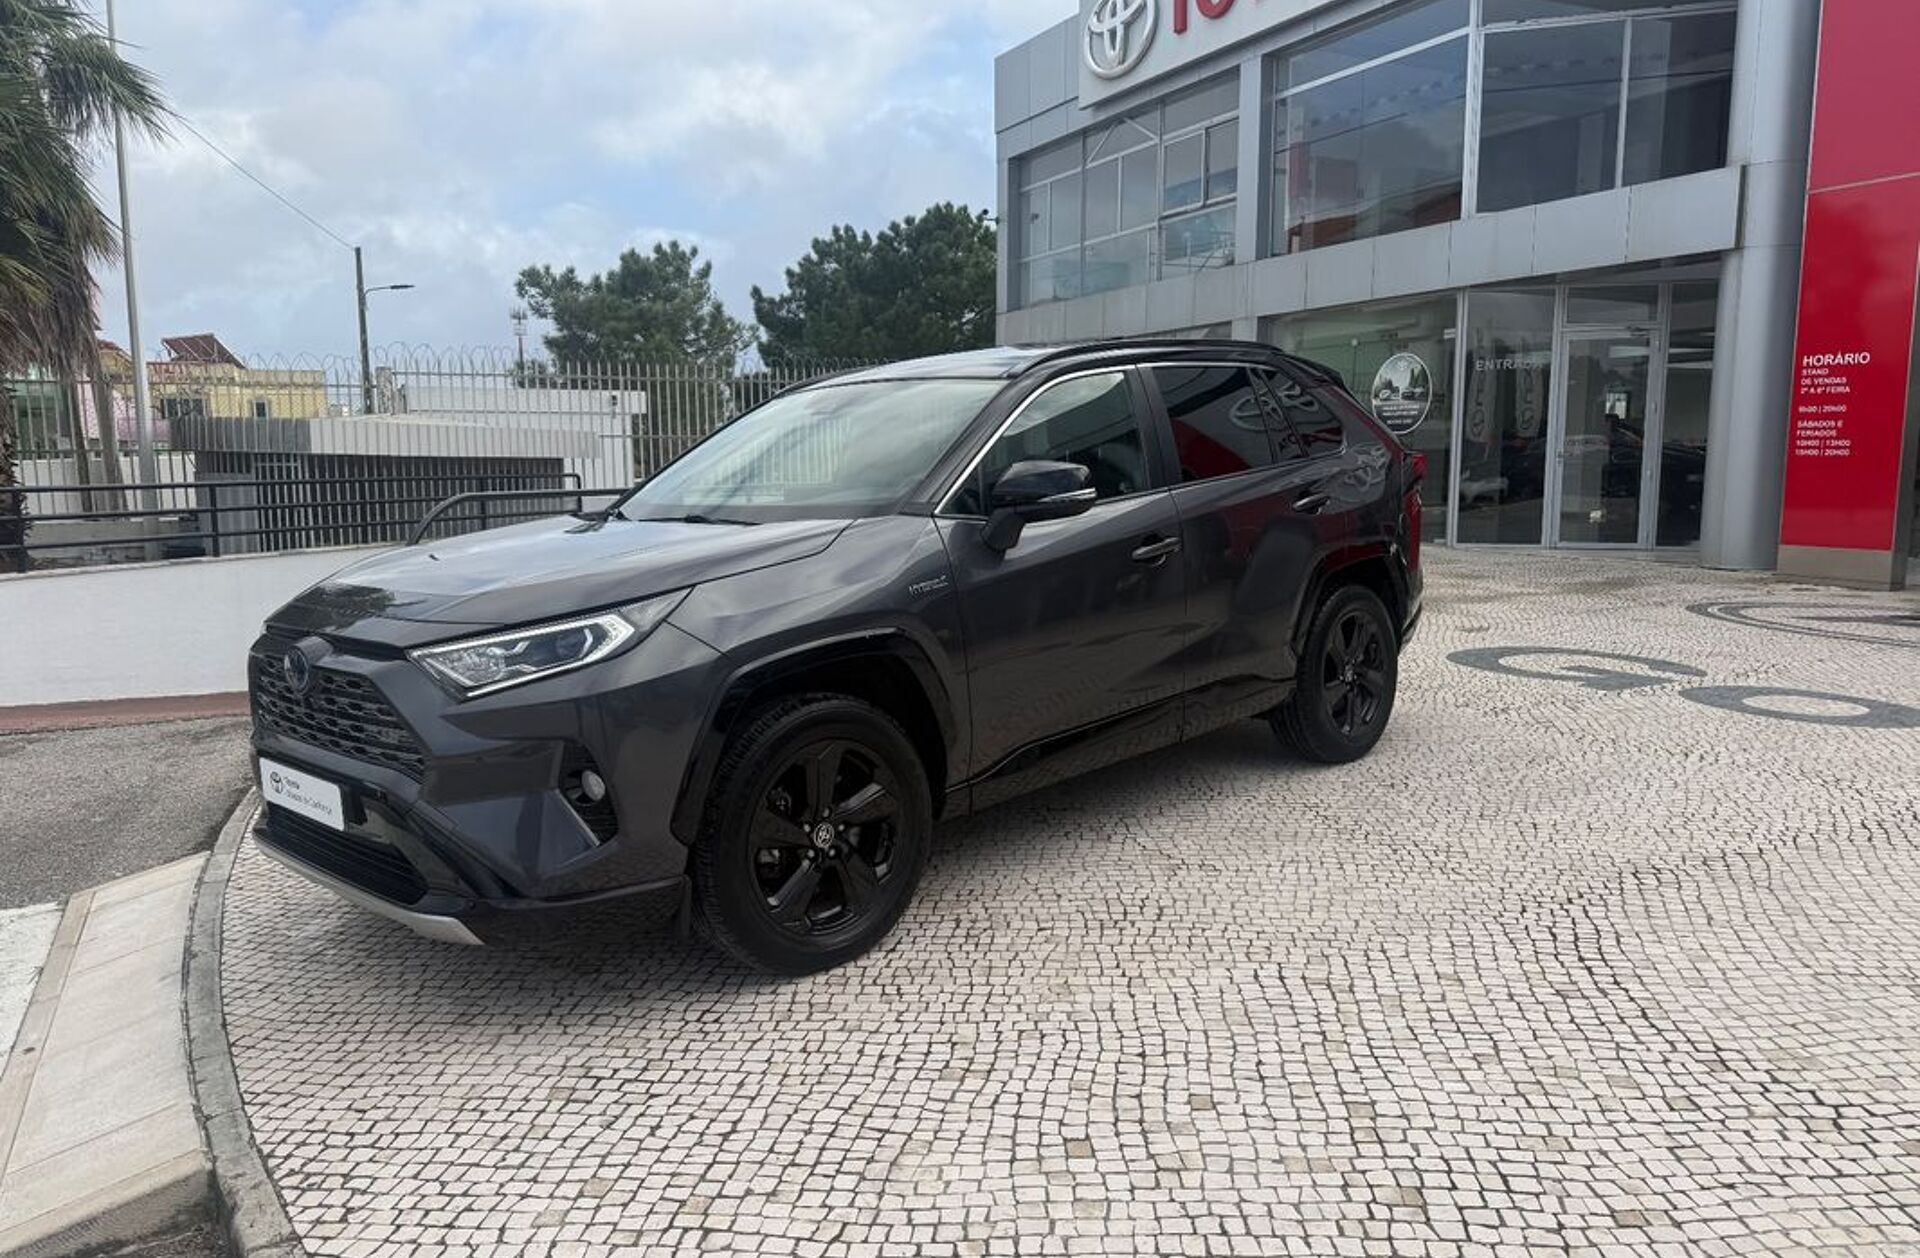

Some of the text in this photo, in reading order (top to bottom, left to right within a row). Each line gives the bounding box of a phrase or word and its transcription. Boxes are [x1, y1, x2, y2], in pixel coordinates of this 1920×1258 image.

[1802, 350, 1871, 367] HORÁRIO
[1475, 358, 1544, 371] ENTRADA
[1801, 368, 1829, 377] STAND
[1813, 376, 1848, 385] VENDAS
[1796, 429, 1837, 437] FERIADOS
